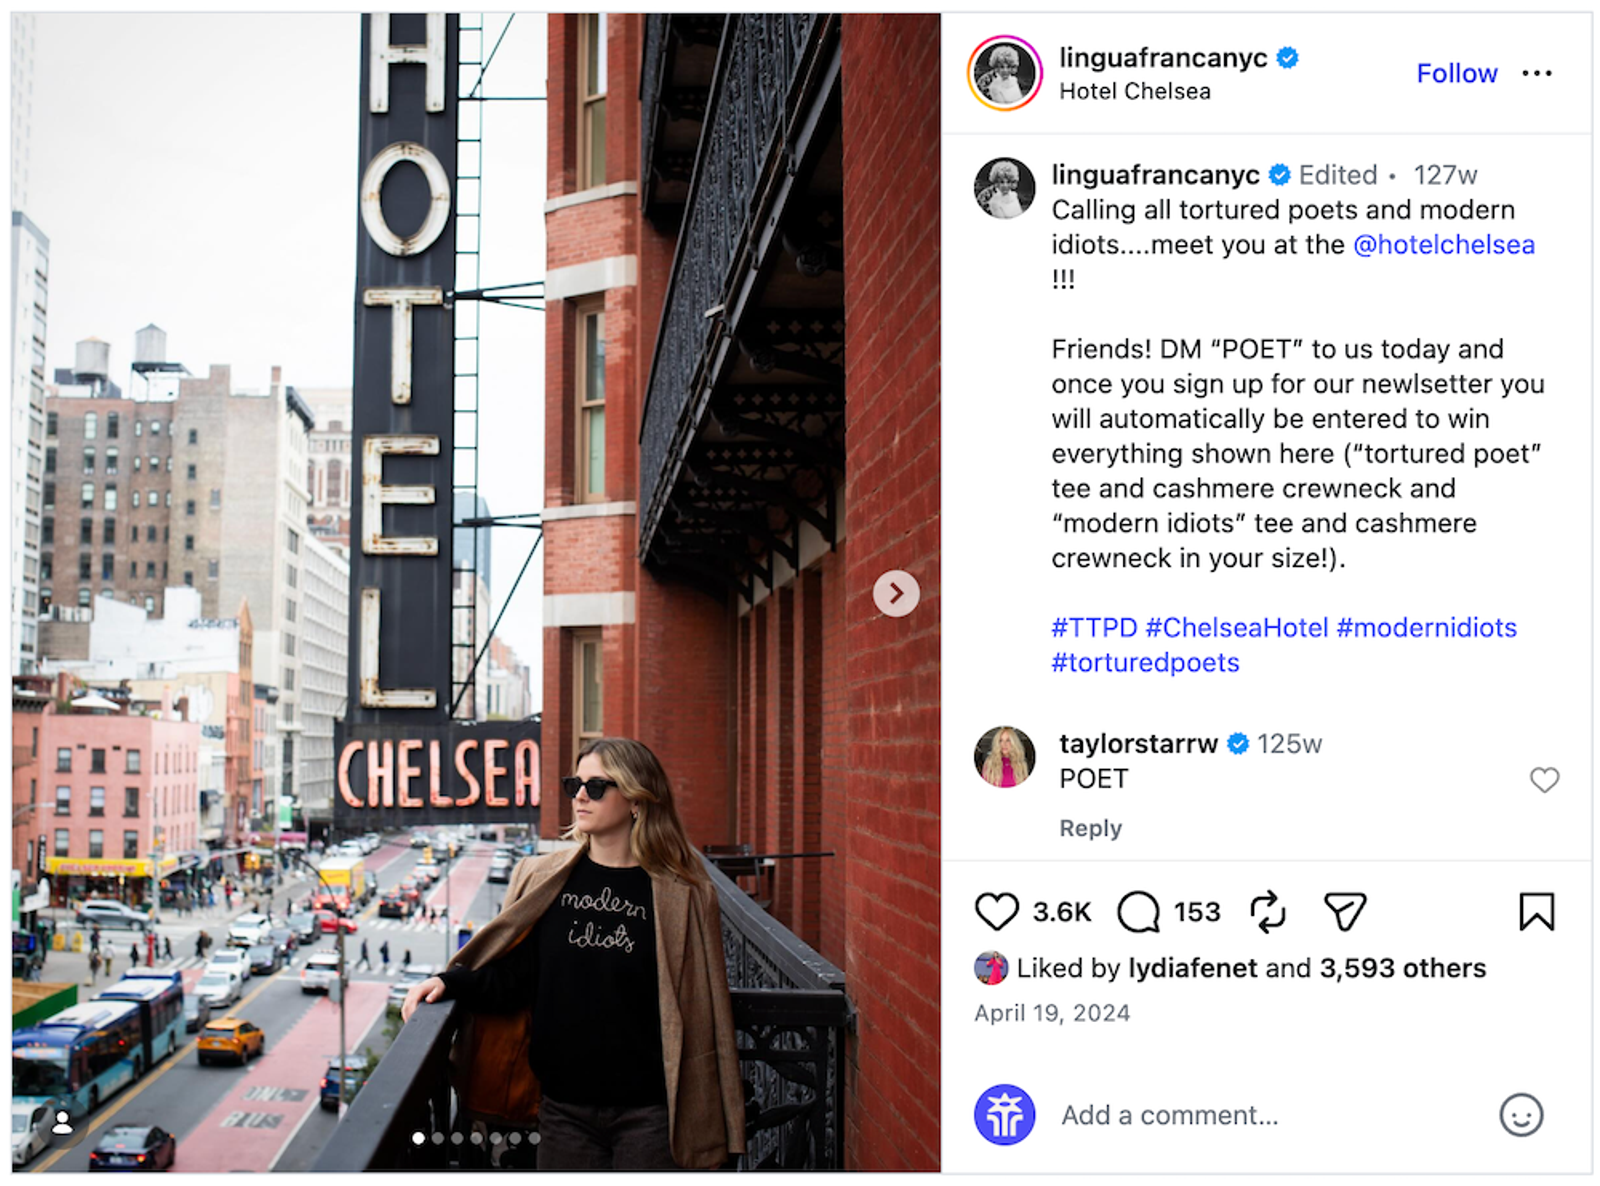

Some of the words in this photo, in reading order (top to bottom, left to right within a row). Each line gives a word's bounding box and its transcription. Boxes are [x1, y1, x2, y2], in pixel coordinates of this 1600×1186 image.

[360, 13, 451, 710] HOTEL
[338, 739, 541, 809] CHELSEA
[561, 886, 646, 920] modern
[568, 921, 635, 954] idiots
